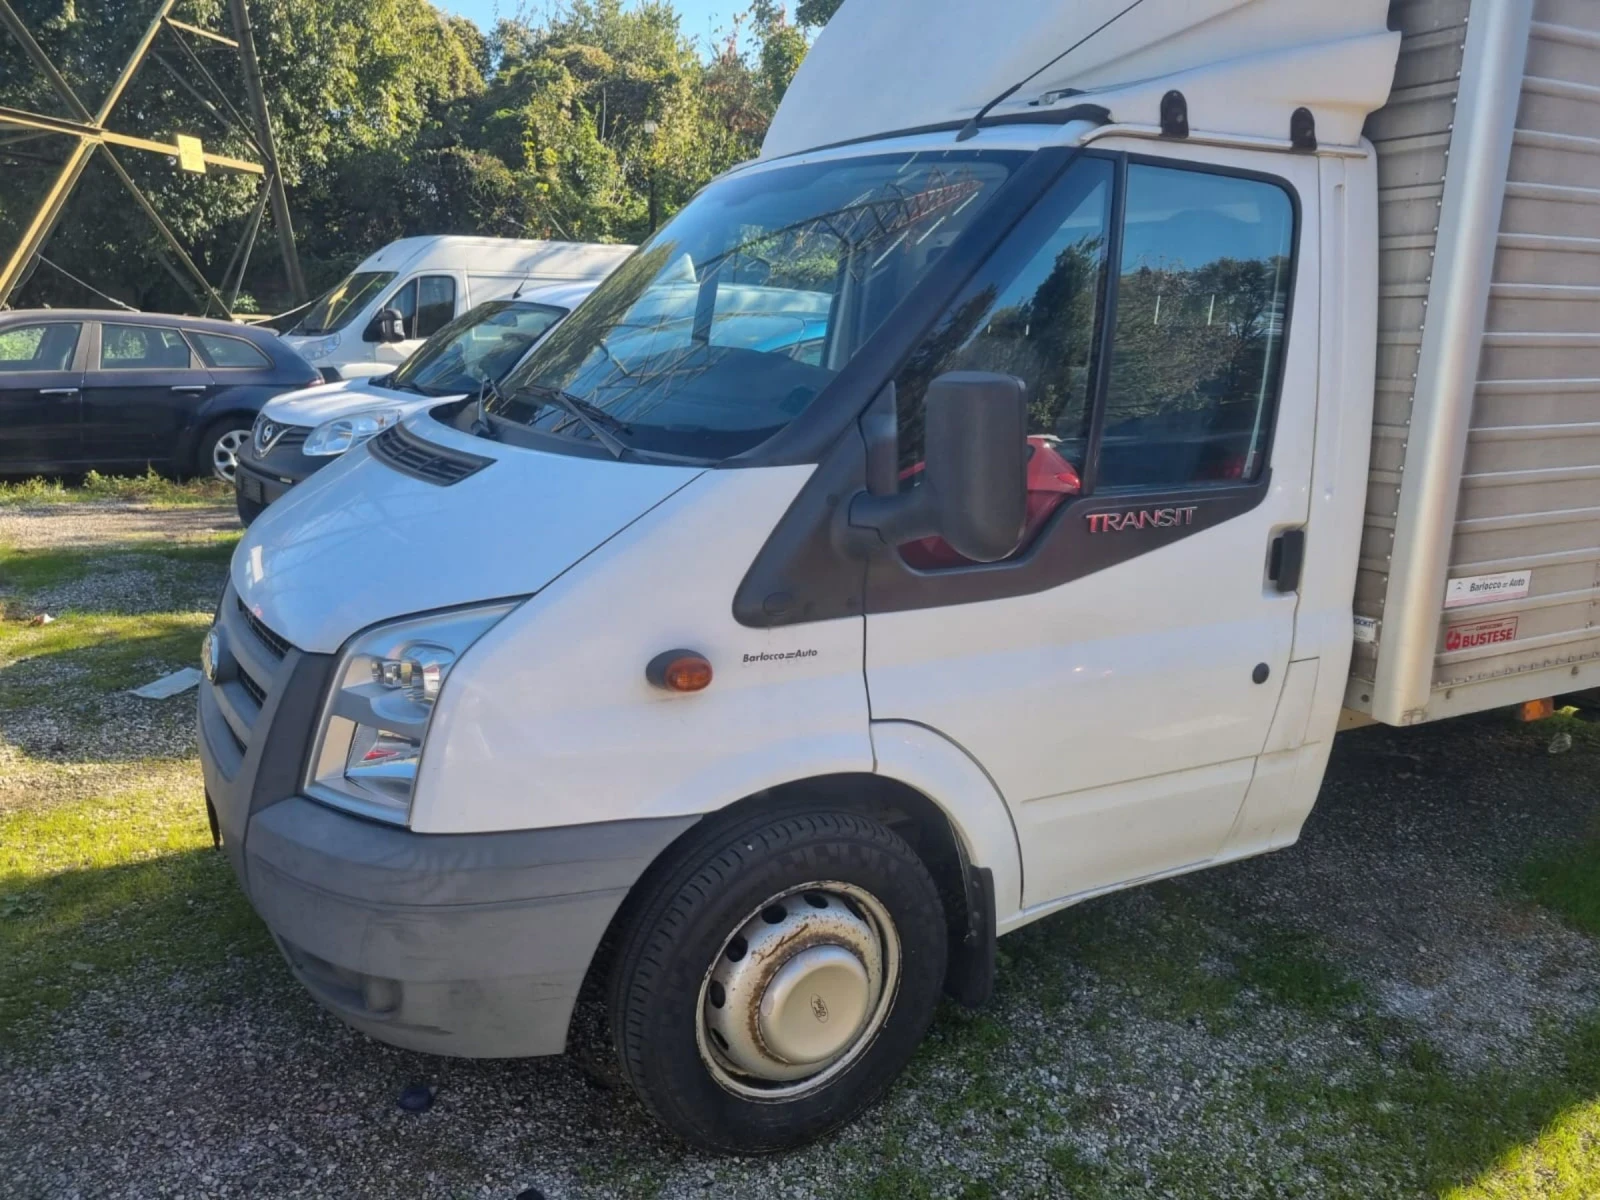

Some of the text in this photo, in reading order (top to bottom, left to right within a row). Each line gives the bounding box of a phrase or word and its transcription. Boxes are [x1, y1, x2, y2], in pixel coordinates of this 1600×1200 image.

[1086, 506, 1198, 533] TRANSIT
[1462, 628, 1513, 647] BUSTESE
[742, 649, 818, 663] Barlocco Auto
